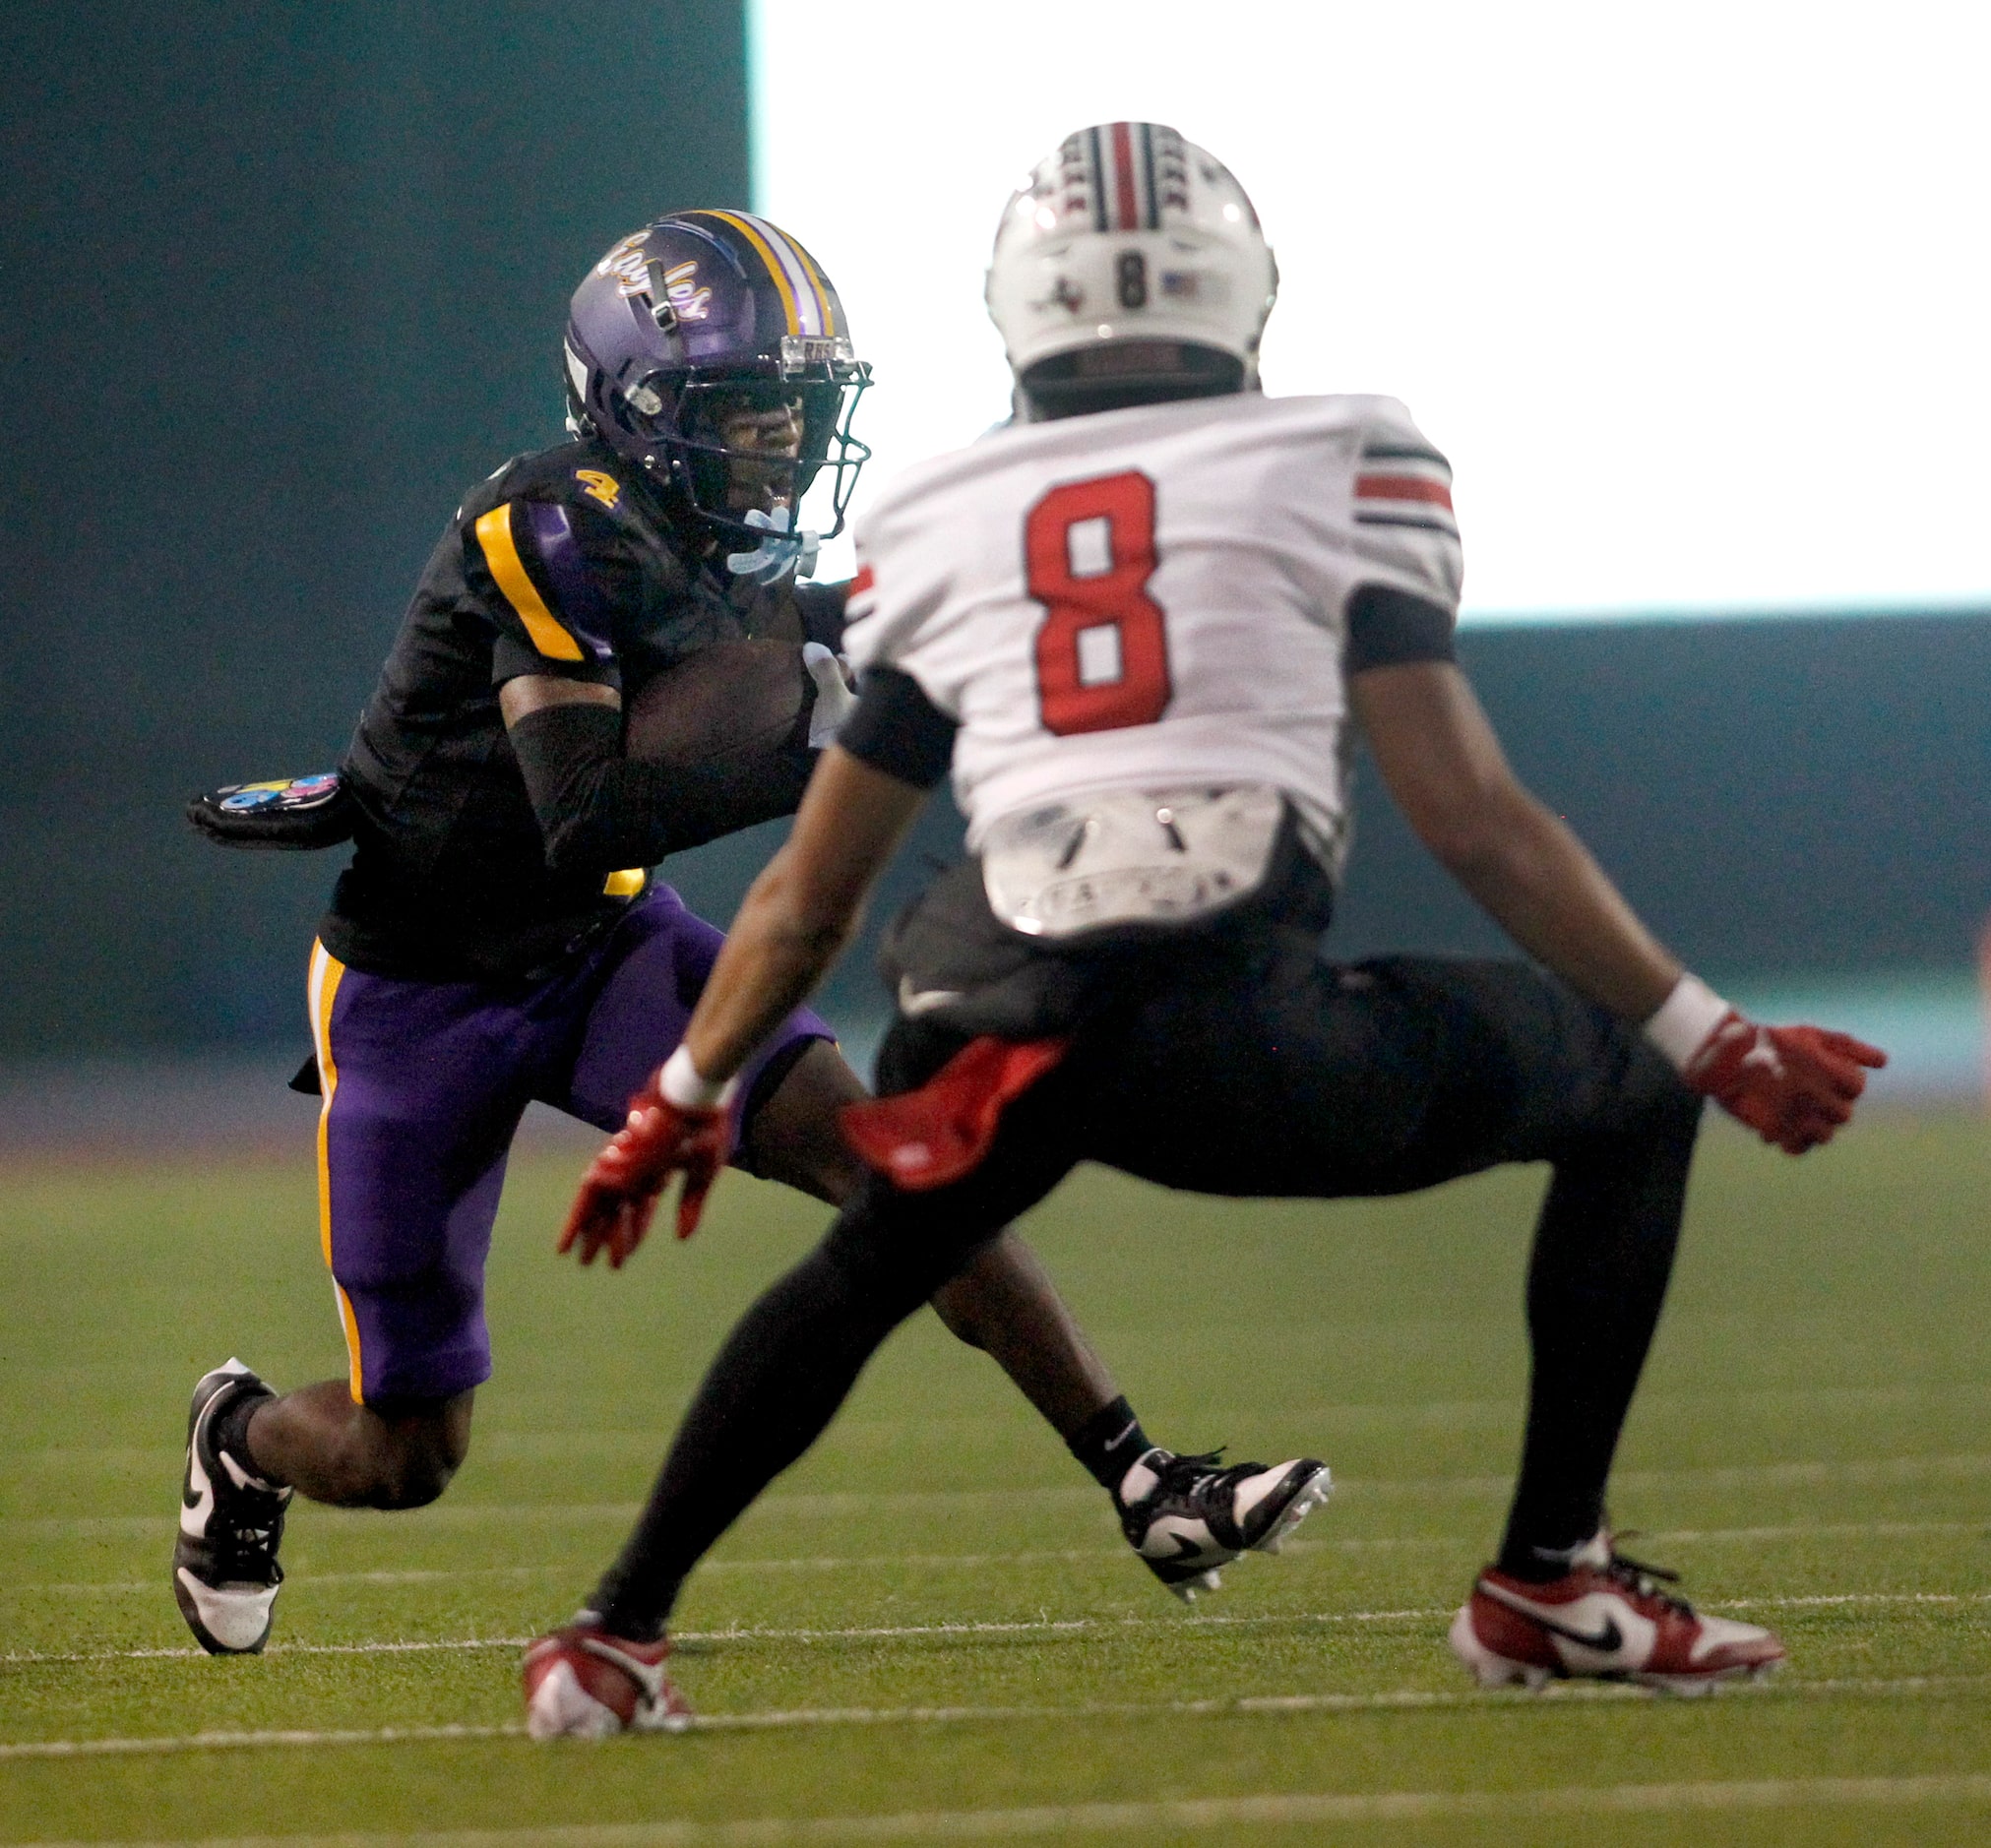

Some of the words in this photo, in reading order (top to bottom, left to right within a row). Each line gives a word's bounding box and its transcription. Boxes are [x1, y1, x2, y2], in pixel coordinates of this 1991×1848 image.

[1116, 248, 1149, 309] 8
[575, 468, 620, 510] 4
[1025, 467, 1173, 736] 8
